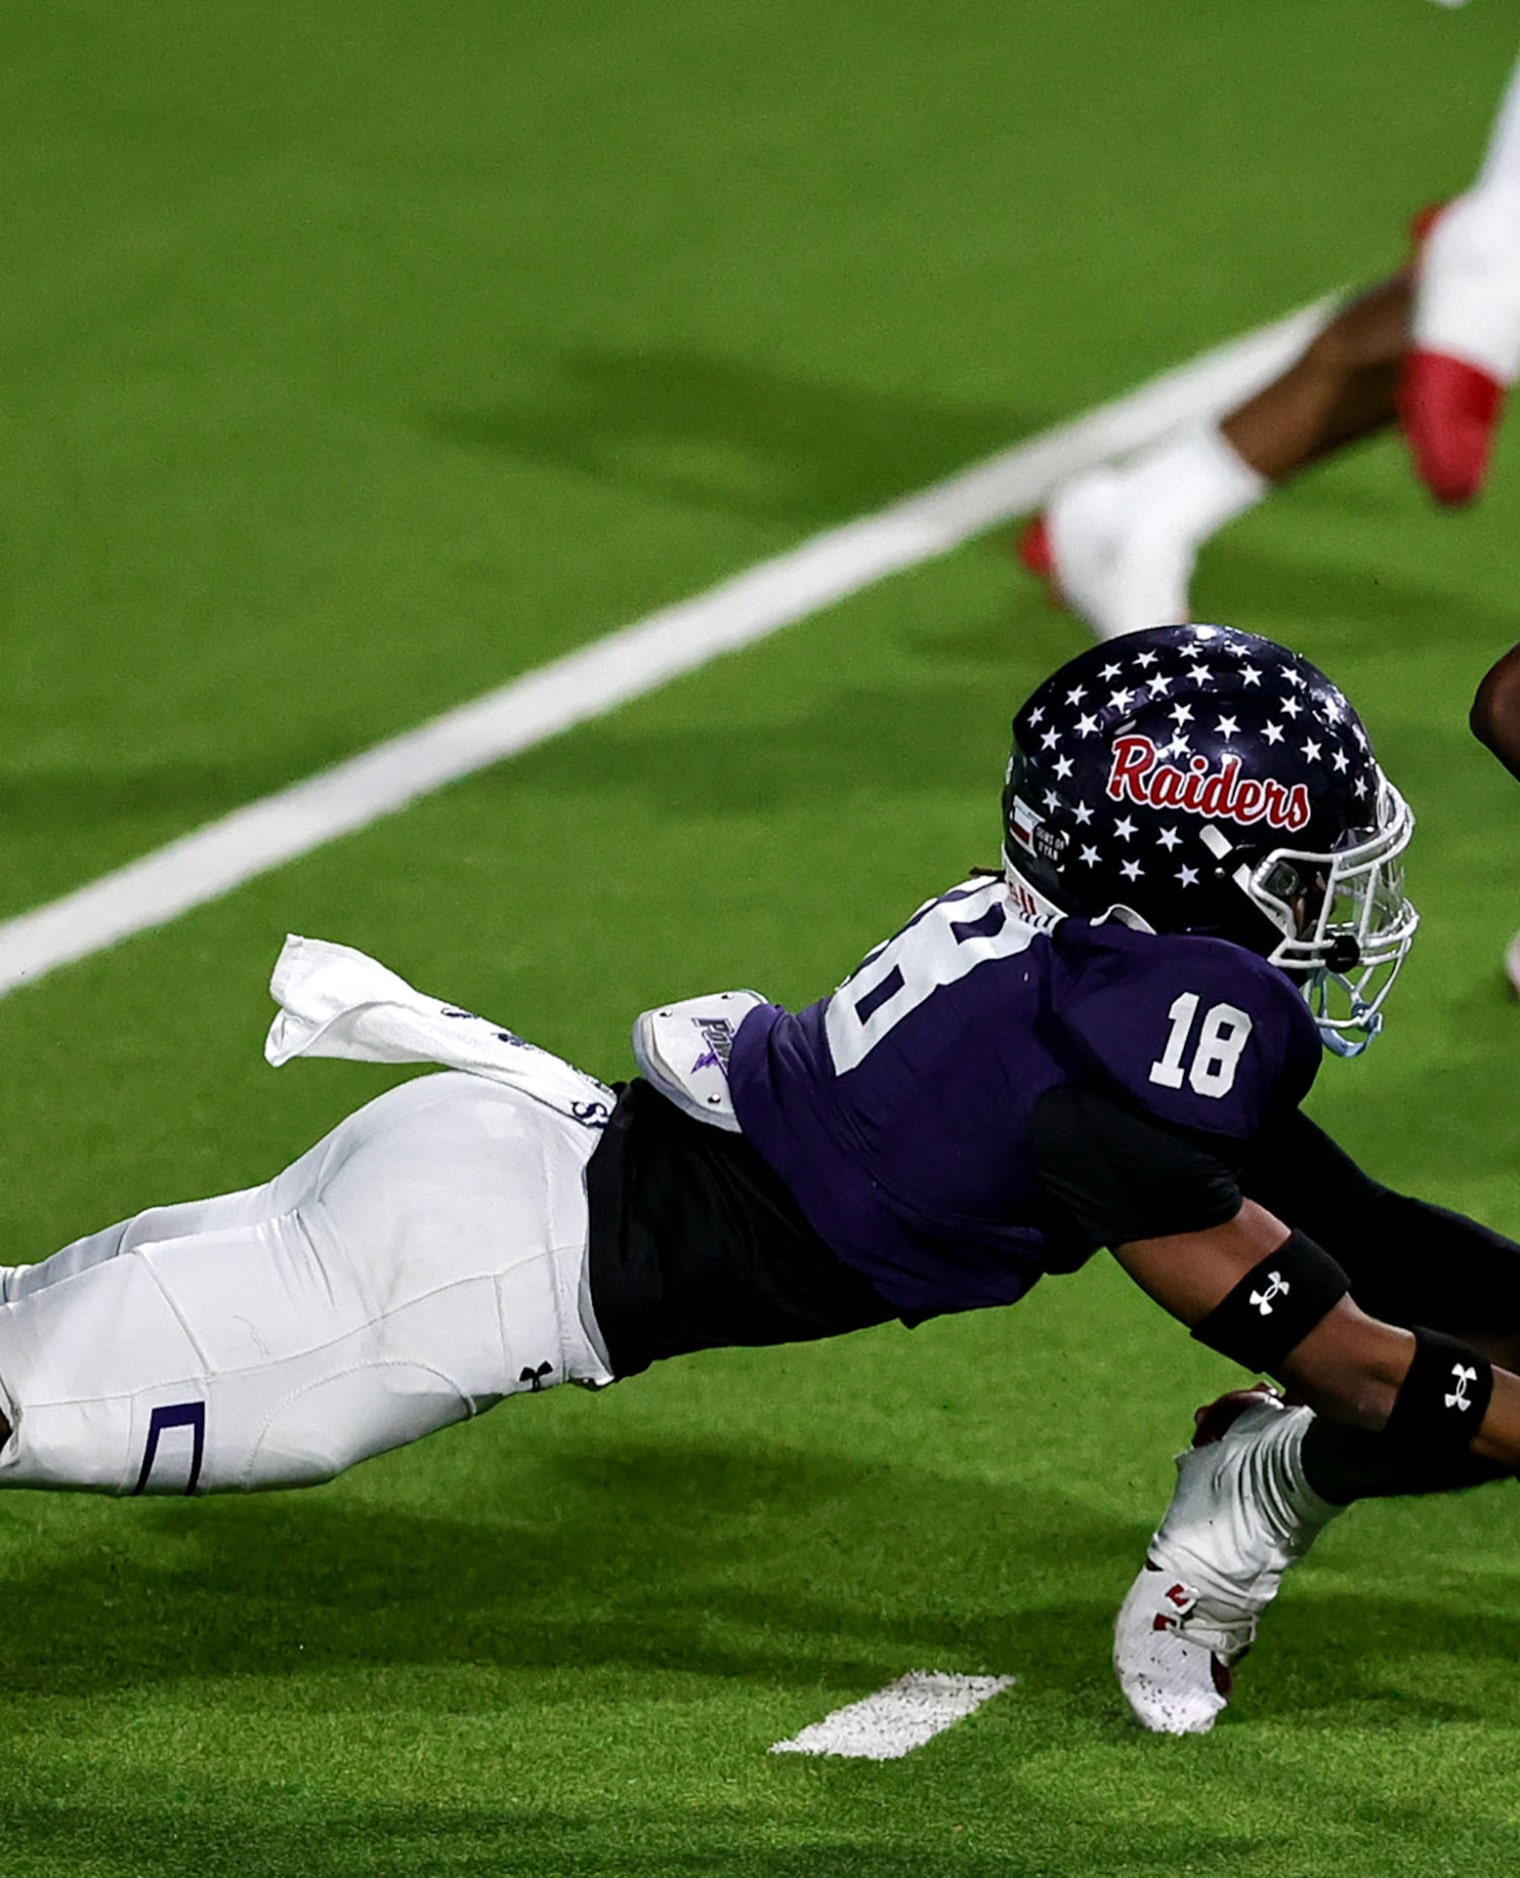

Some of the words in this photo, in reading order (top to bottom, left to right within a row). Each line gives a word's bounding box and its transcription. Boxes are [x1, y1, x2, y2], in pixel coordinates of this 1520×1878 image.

[1106, 733, 1311, 832] Raiders
[690, 1017, 735, 1076] POW
[1148, 991, 1253, 1098] 18
